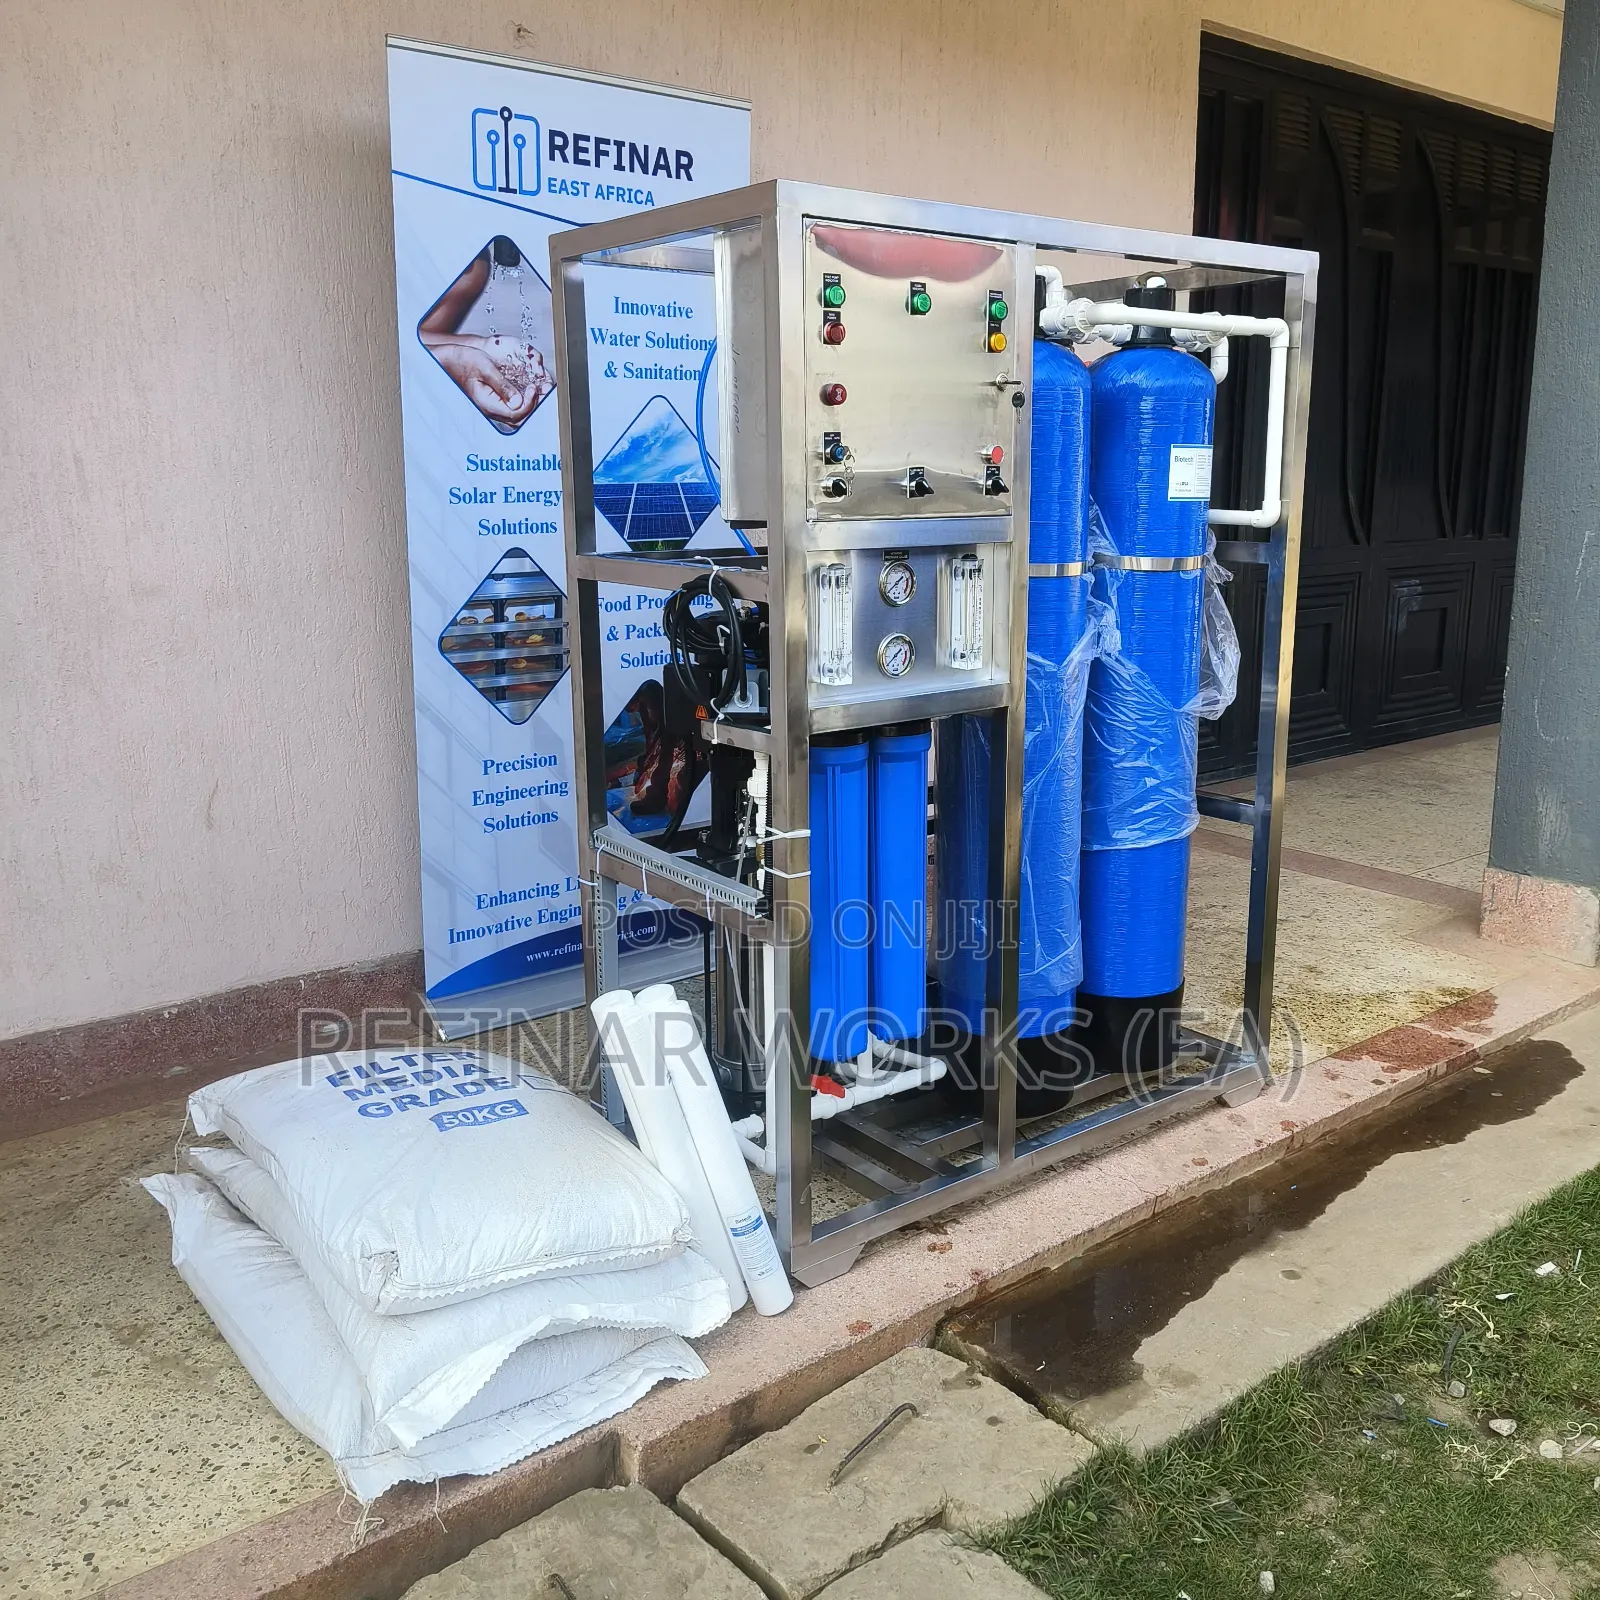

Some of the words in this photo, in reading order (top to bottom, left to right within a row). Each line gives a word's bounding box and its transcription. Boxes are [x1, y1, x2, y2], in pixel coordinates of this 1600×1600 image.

[548, 129, 694, 182] REFINAR
[547, 177, 590, 199] EAST
[595, 184, 655, 206] AFRICA
[613, 296, 694, 319] Innovative
[590, 327, 641, 349] Water
[604, 361, 618, 379] &
[623, 361, 702, 382] Sanitation
[448, 486, 497, 505] Solar
[502, 486, 563, 507] Energy
[478, 517, 558, 537] Solutions
[606, 625, 620, 642] &
[482, 752, 558, 776] Precision
[472, 779, 569, 807] Engineering
[483, 809, 559, 834] Solutions
[476, 881, 560, 911] Enhancing
[448, 914, 533, 945] Innovative
[326, 1051, 485, 1088] FILTER
[343, 1063, 496, 1101] MEDIA
[357, 1077, 516, 1118] GRADE
[441, 1102, 519, 1129] 50KG
